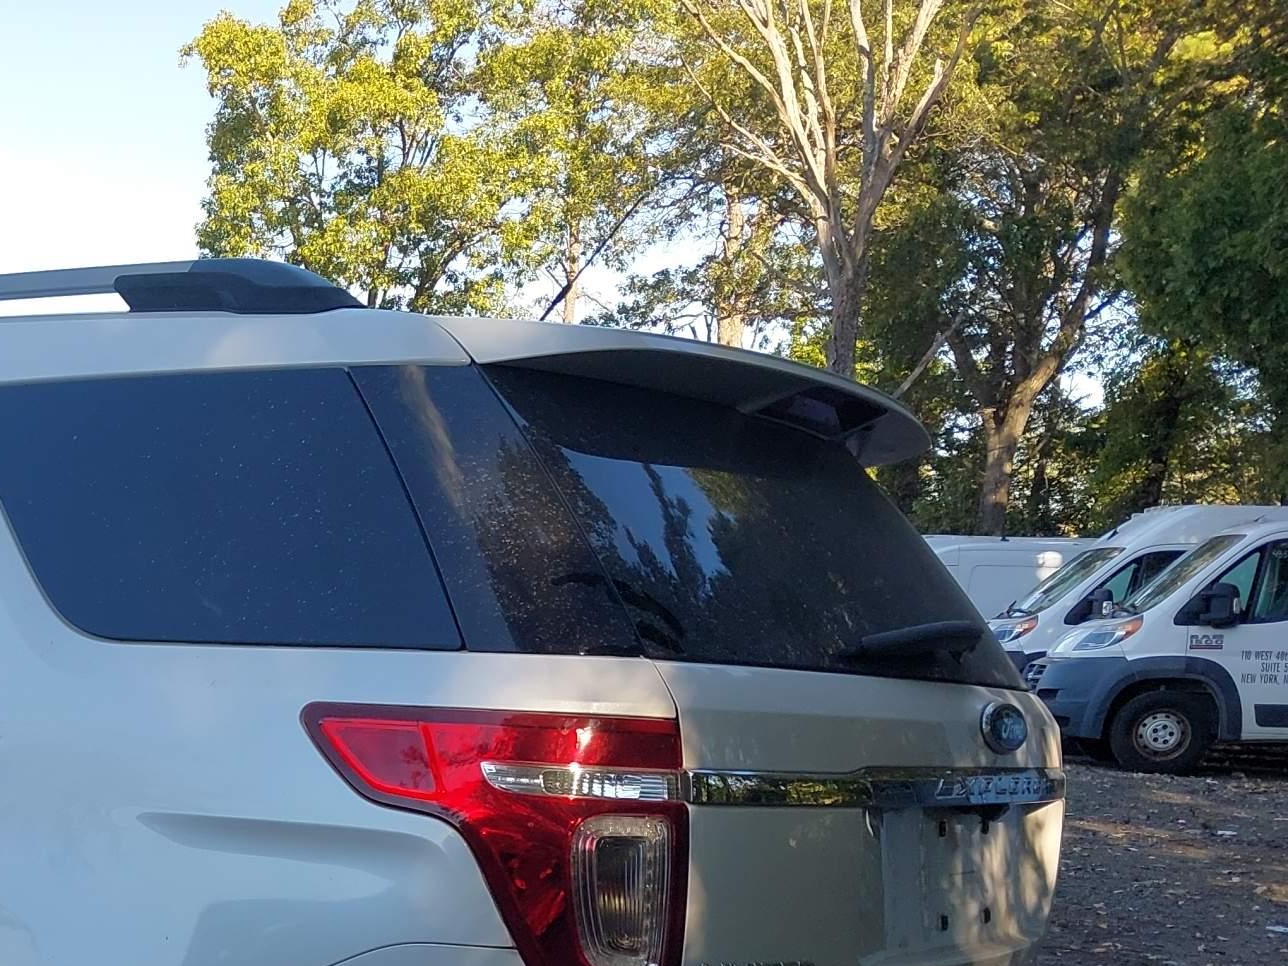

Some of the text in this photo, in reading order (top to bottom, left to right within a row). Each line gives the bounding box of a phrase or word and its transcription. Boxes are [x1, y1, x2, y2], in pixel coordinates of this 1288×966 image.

[1254, 650, 1273, 661] WEST
[1261, 662, 1281, 673] SUITE
[1241, 673, 1257, 684] NEW
